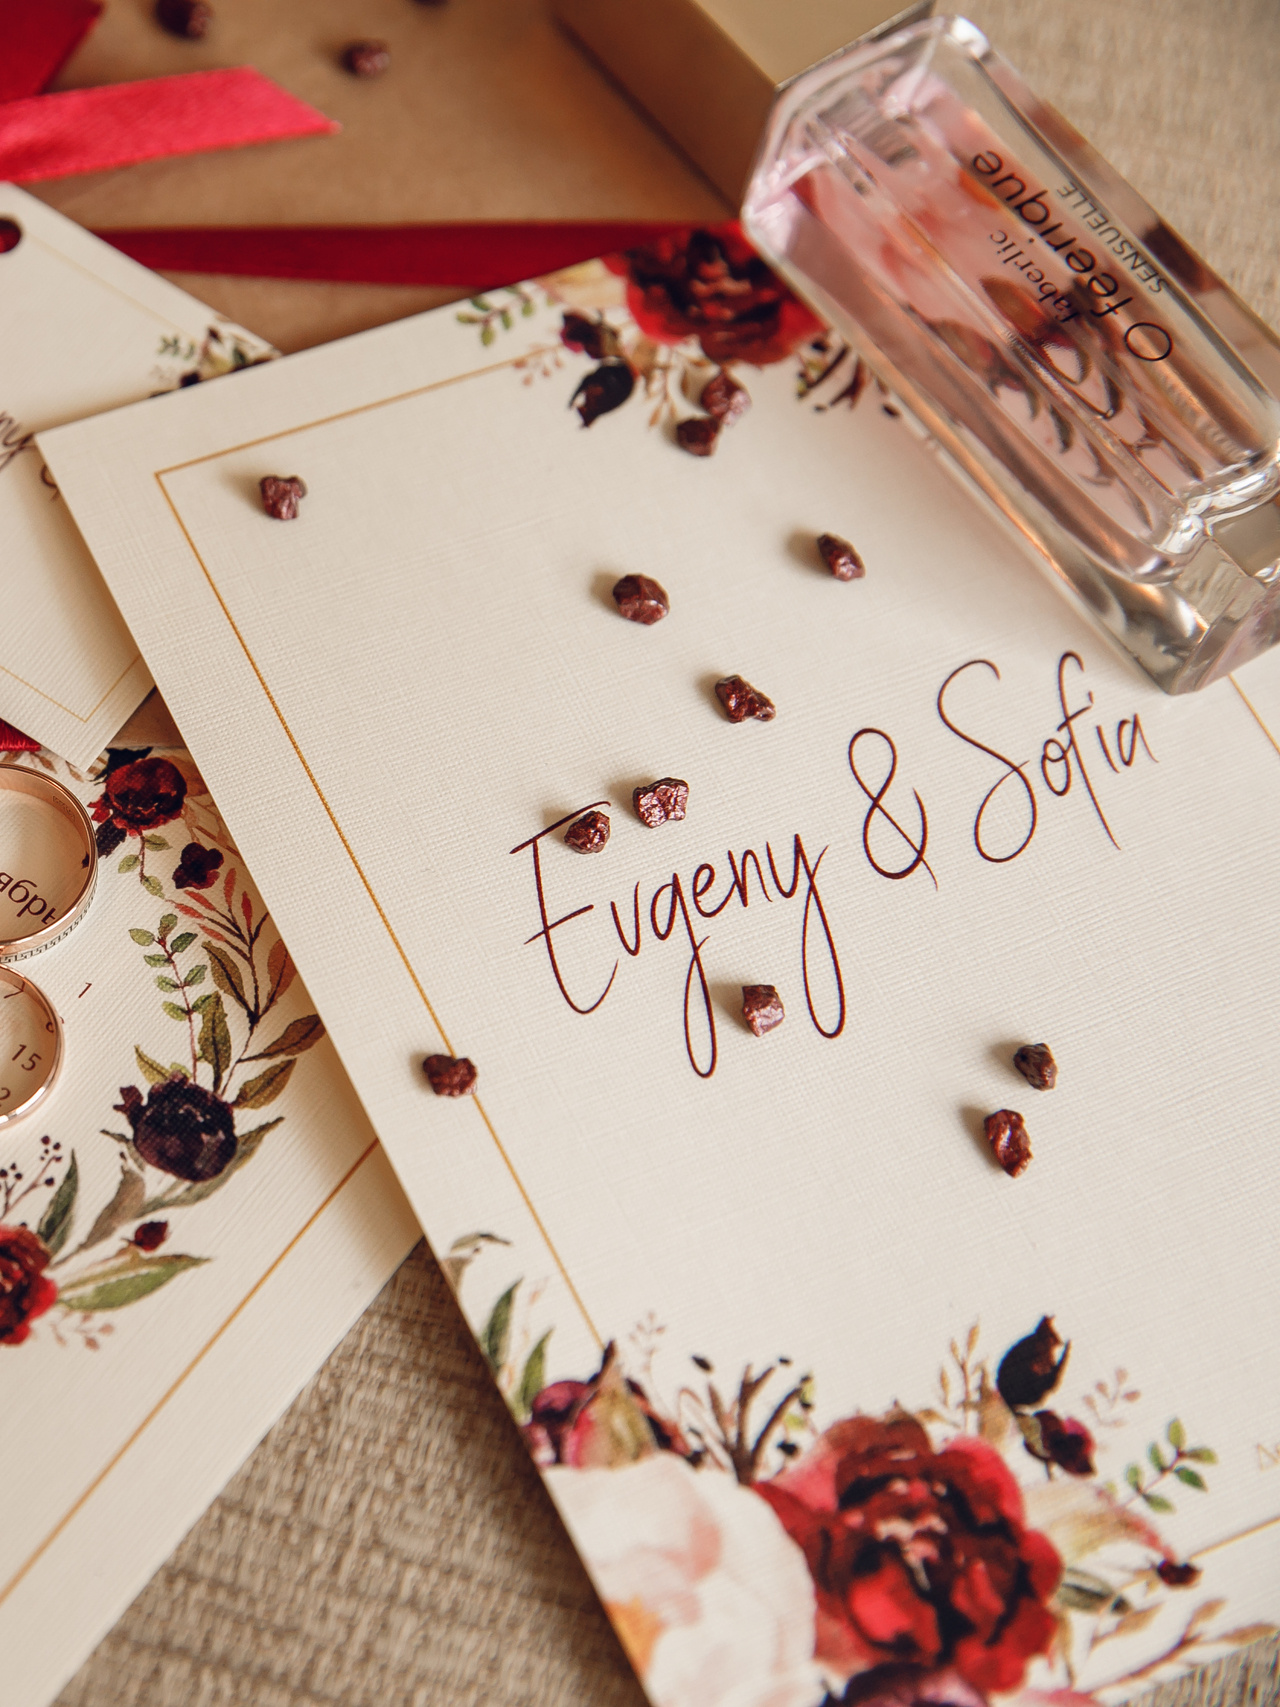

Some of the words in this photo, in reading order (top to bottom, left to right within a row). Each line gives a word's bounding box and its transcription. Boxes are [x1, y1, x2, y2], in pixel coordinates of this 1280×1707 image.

[972, 150, 1133, 317] feerique
[989, 229, 1080, 324] faberlic
[1056, 180, 1166, 294] SENSUELLE
[1124, 322, 1172, 361] O
[509, 800, 845, 1078] Evgeny
[848, 728, 938, 890] &
[937, 651, 1159, 862] Sofia
[11, 1044, 42, 1071] 15
